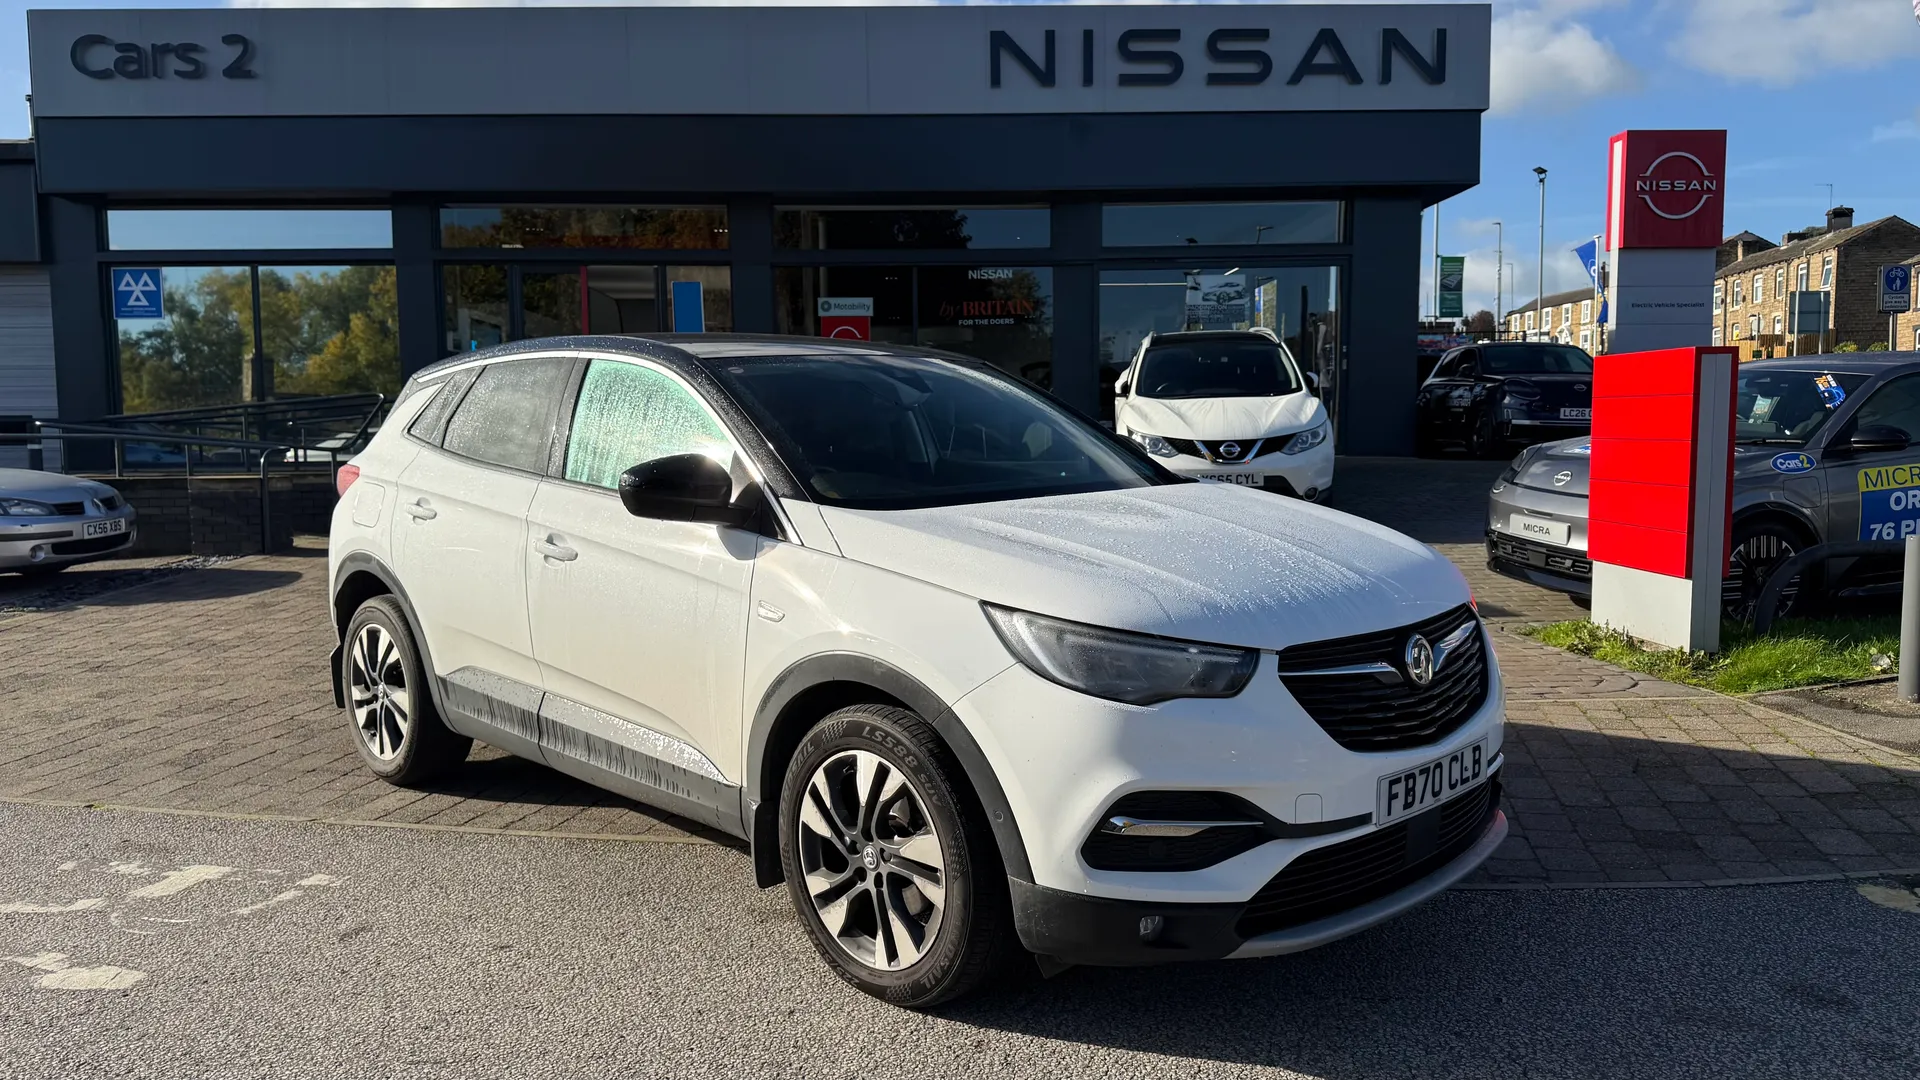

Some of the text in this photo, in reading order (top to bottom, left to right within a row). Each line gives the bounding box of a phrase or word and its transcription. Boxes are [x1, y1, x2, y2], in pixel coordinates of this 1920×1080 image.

[70, 33, 258, 79] Cars 2
[989, 27, 1448, 89] NISSAN
[1636, 180, 1717, 191] NISSAN
[968, 269, 1013, 279] NISSAN
[834, 303, 871, 312] Motability
[1563, 409, 1587, 417] LC26
[1236, 474, 1259, 485] CYL
[1889, 490, 1920, 511] OR
[87, 522, 108, 536] CX56
[1523, 523, 1551, 536] MICRA
[1869, 521, 1895, 541] 76
[862, 726, 943, 807] LS588 SUV
[1387, 744, 1482, 817] FB70 CLB
